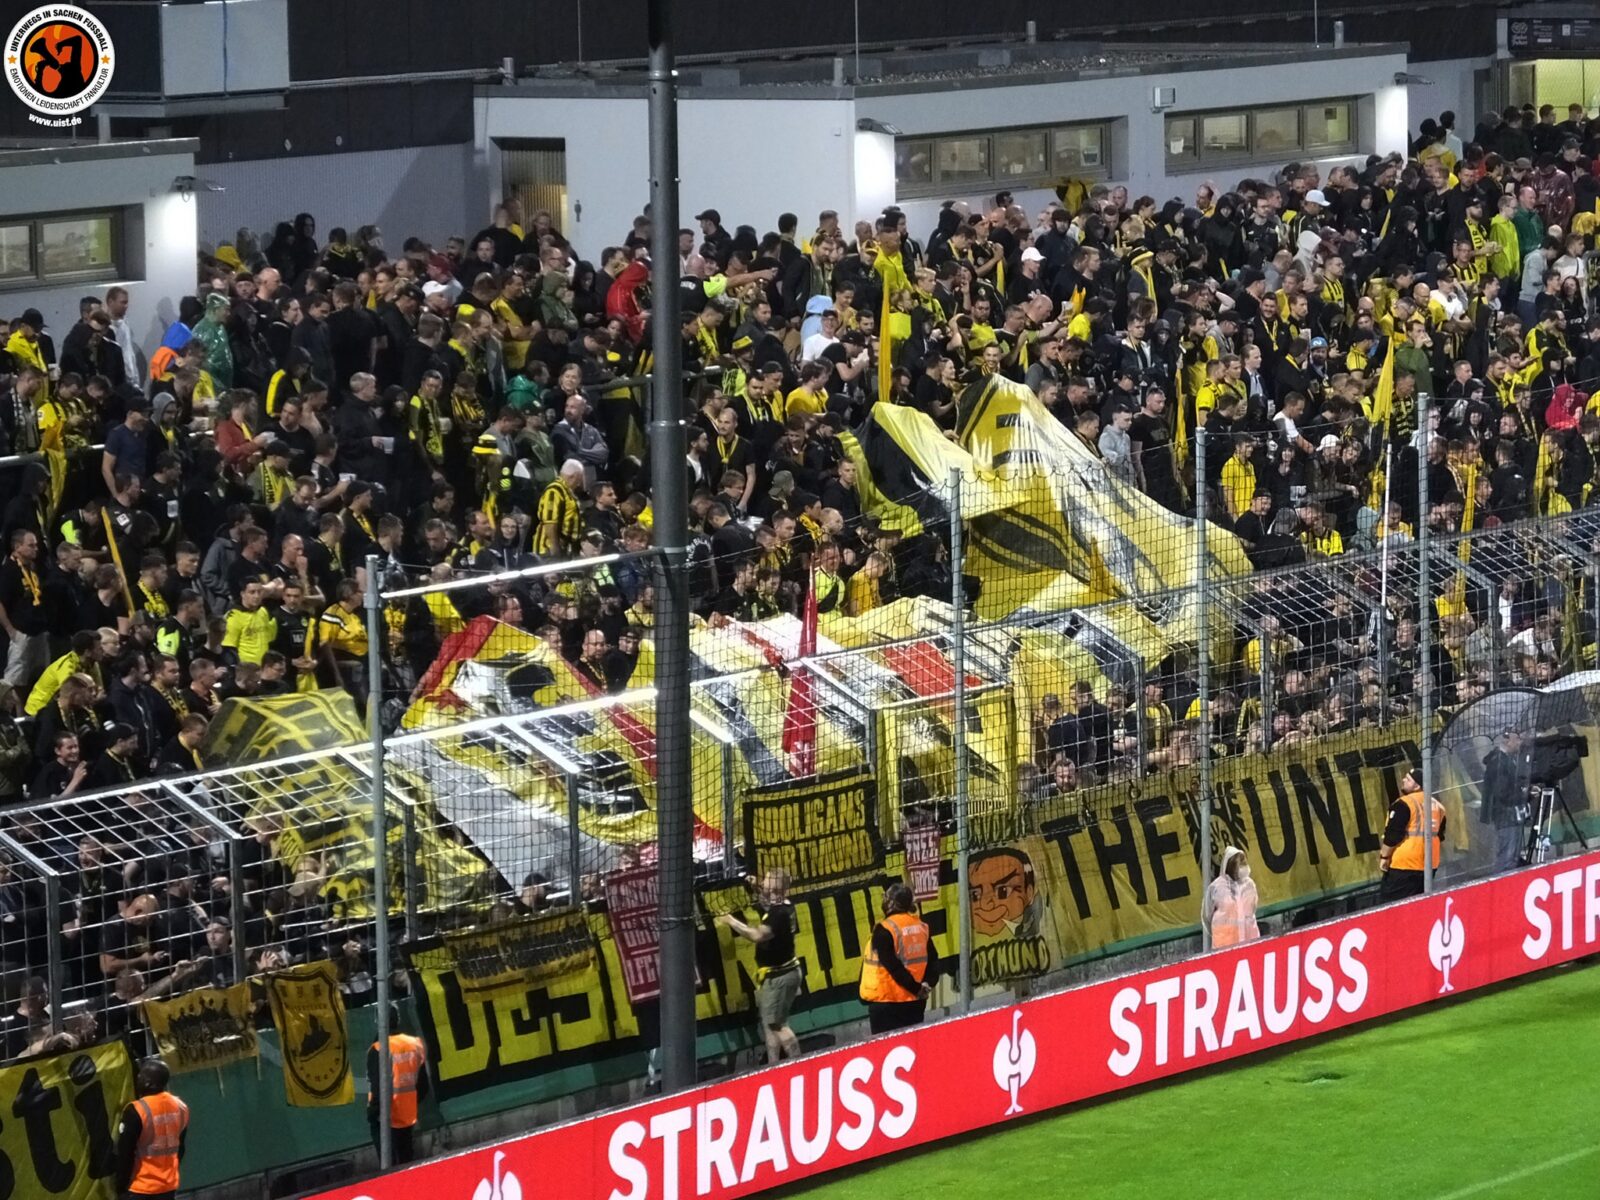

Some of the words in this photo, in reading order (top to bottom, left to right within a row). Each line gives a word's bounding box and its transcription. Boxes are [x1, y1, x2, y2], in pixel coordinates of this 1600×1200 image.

[753, 788, 867, 843] HOOLIGANS
[757, 828, 874, 884] DORTMUND
[1041, 795, 1190, 921] THE
[966, 936, 1050, 984] ORTMUND
[1107, 928, 1369, 1077] STRAUSS
[607, 1045, 918, 1200] STRAUSS
